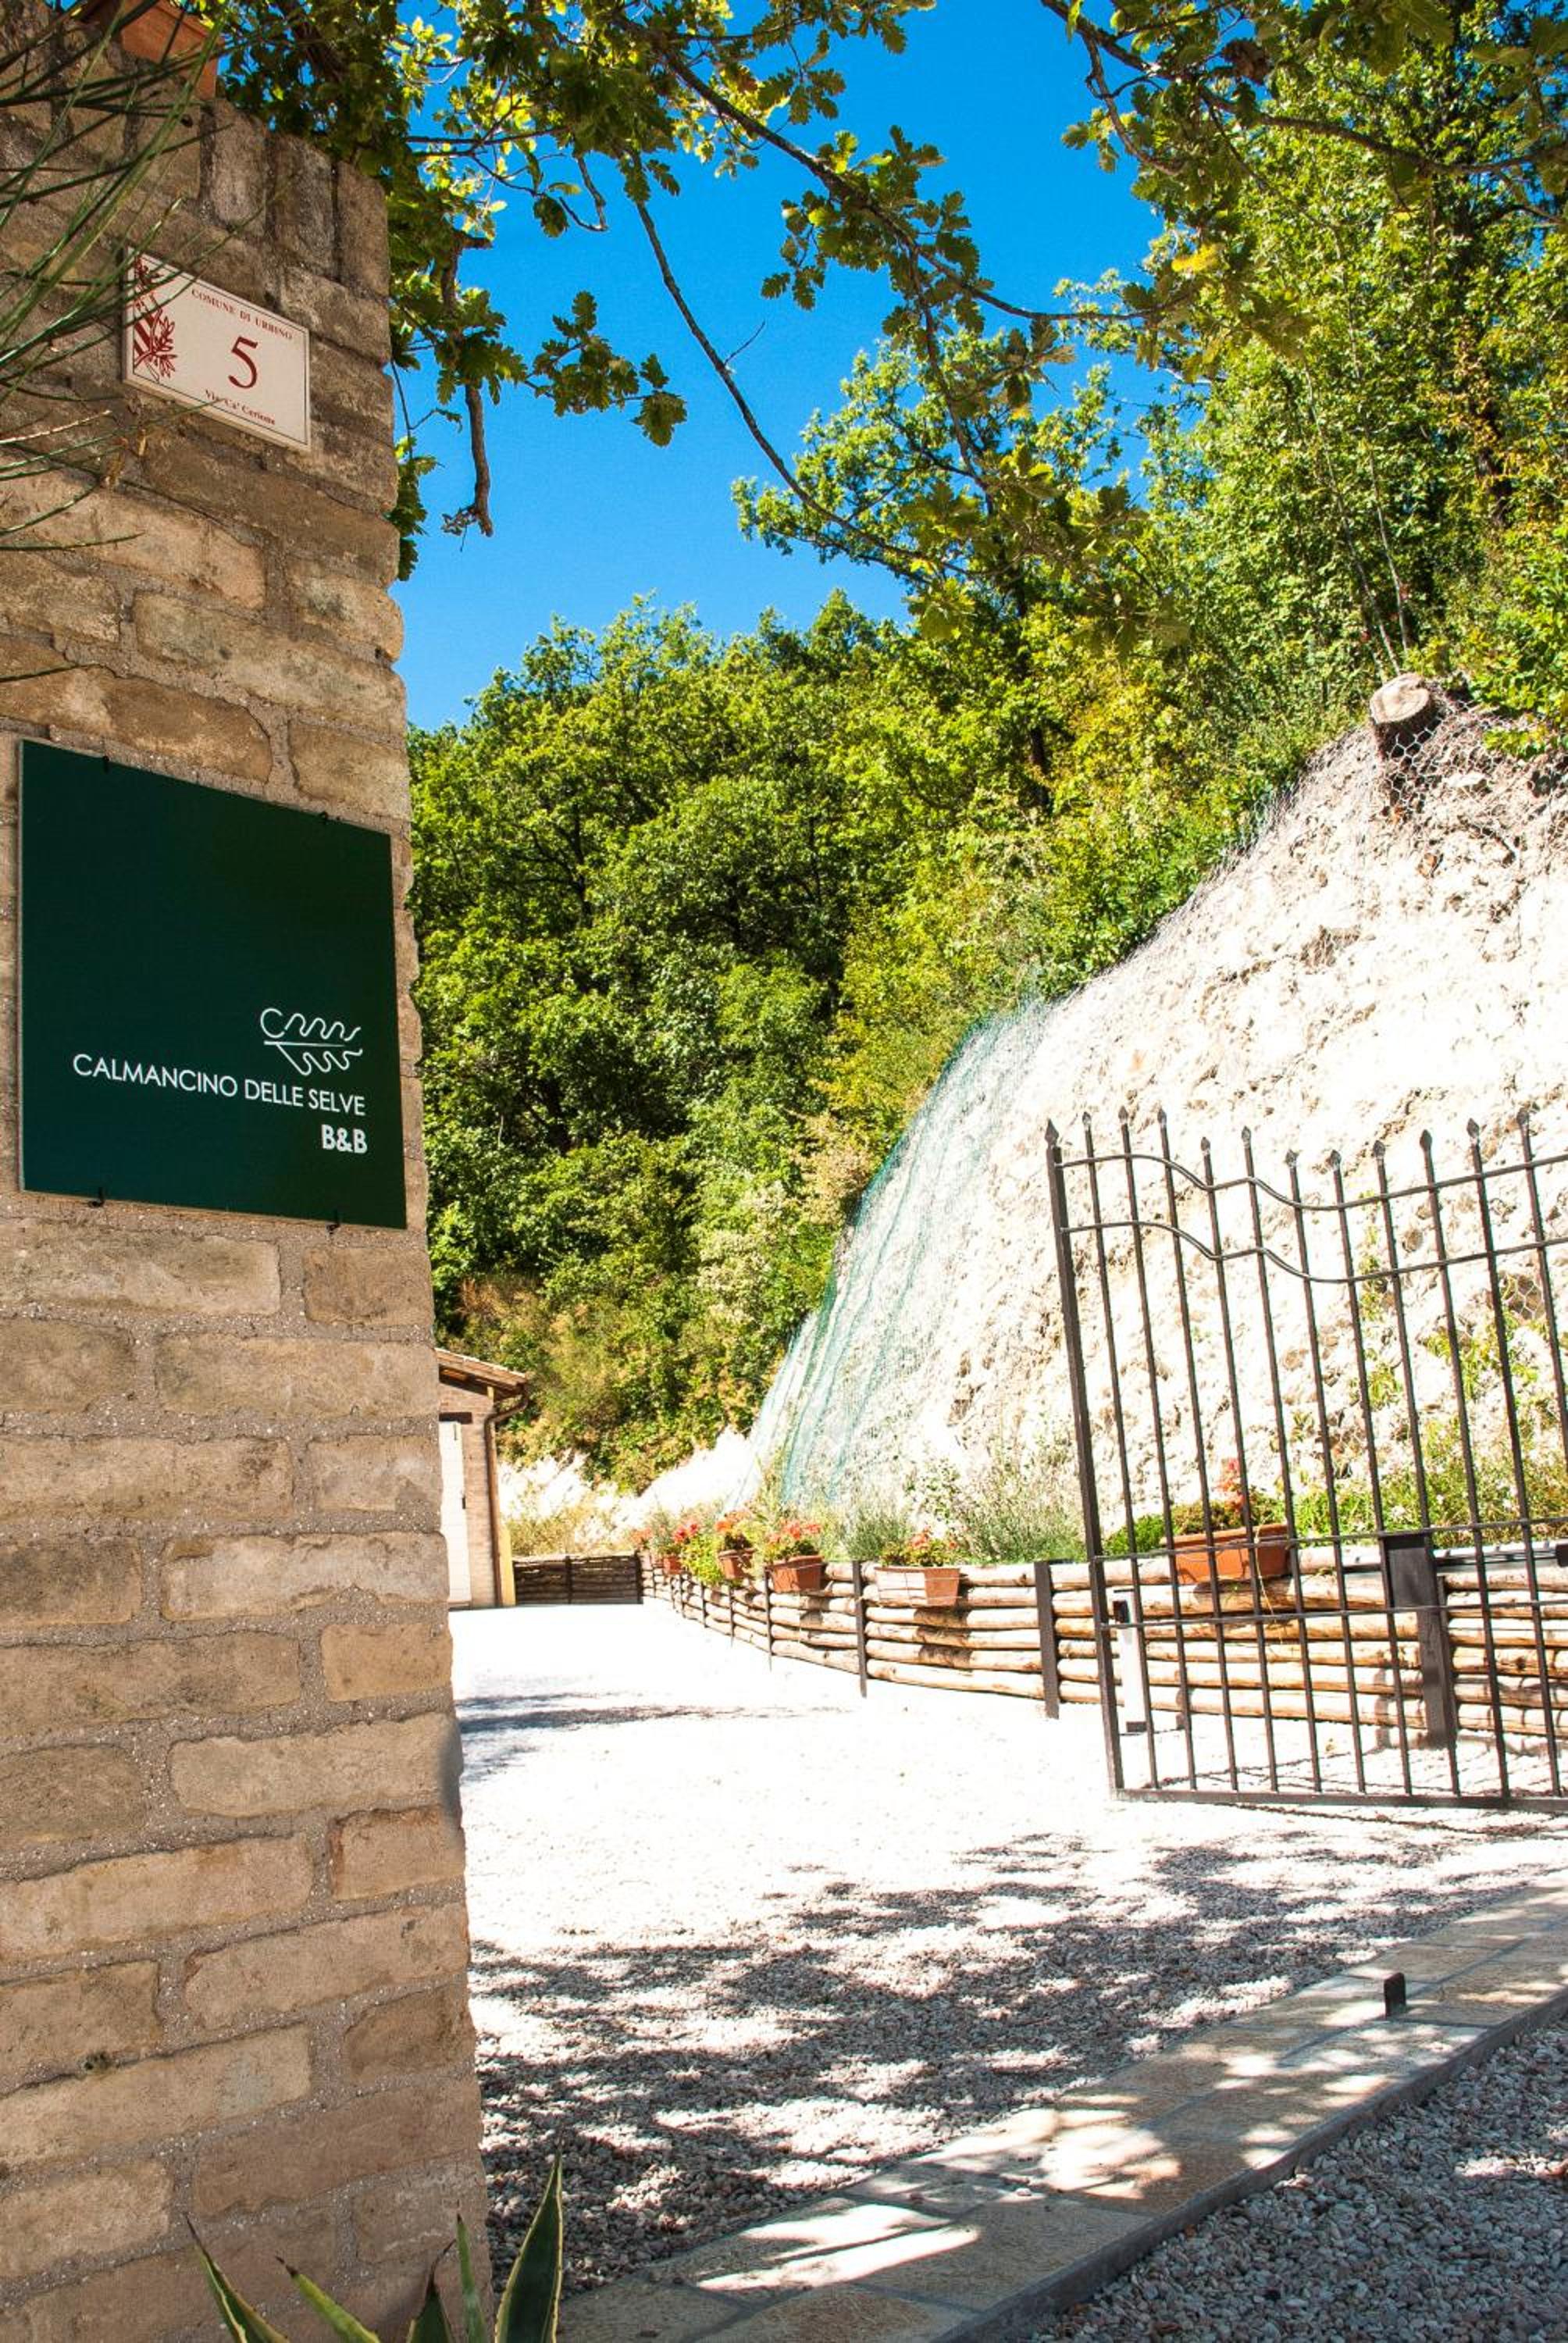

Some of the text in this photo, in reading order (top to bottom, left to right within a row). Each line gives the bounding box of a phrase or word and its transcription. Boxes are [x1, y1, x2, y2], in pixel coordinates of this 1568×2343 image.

[191, 288, 293, 340] COMUNE DI URBINO
[228, 336, 260, 390] 5
[73, 1053, 366, 1116] CALMANCINO DELLE SELVE
[321, 1124, 368, 1154] B&B
